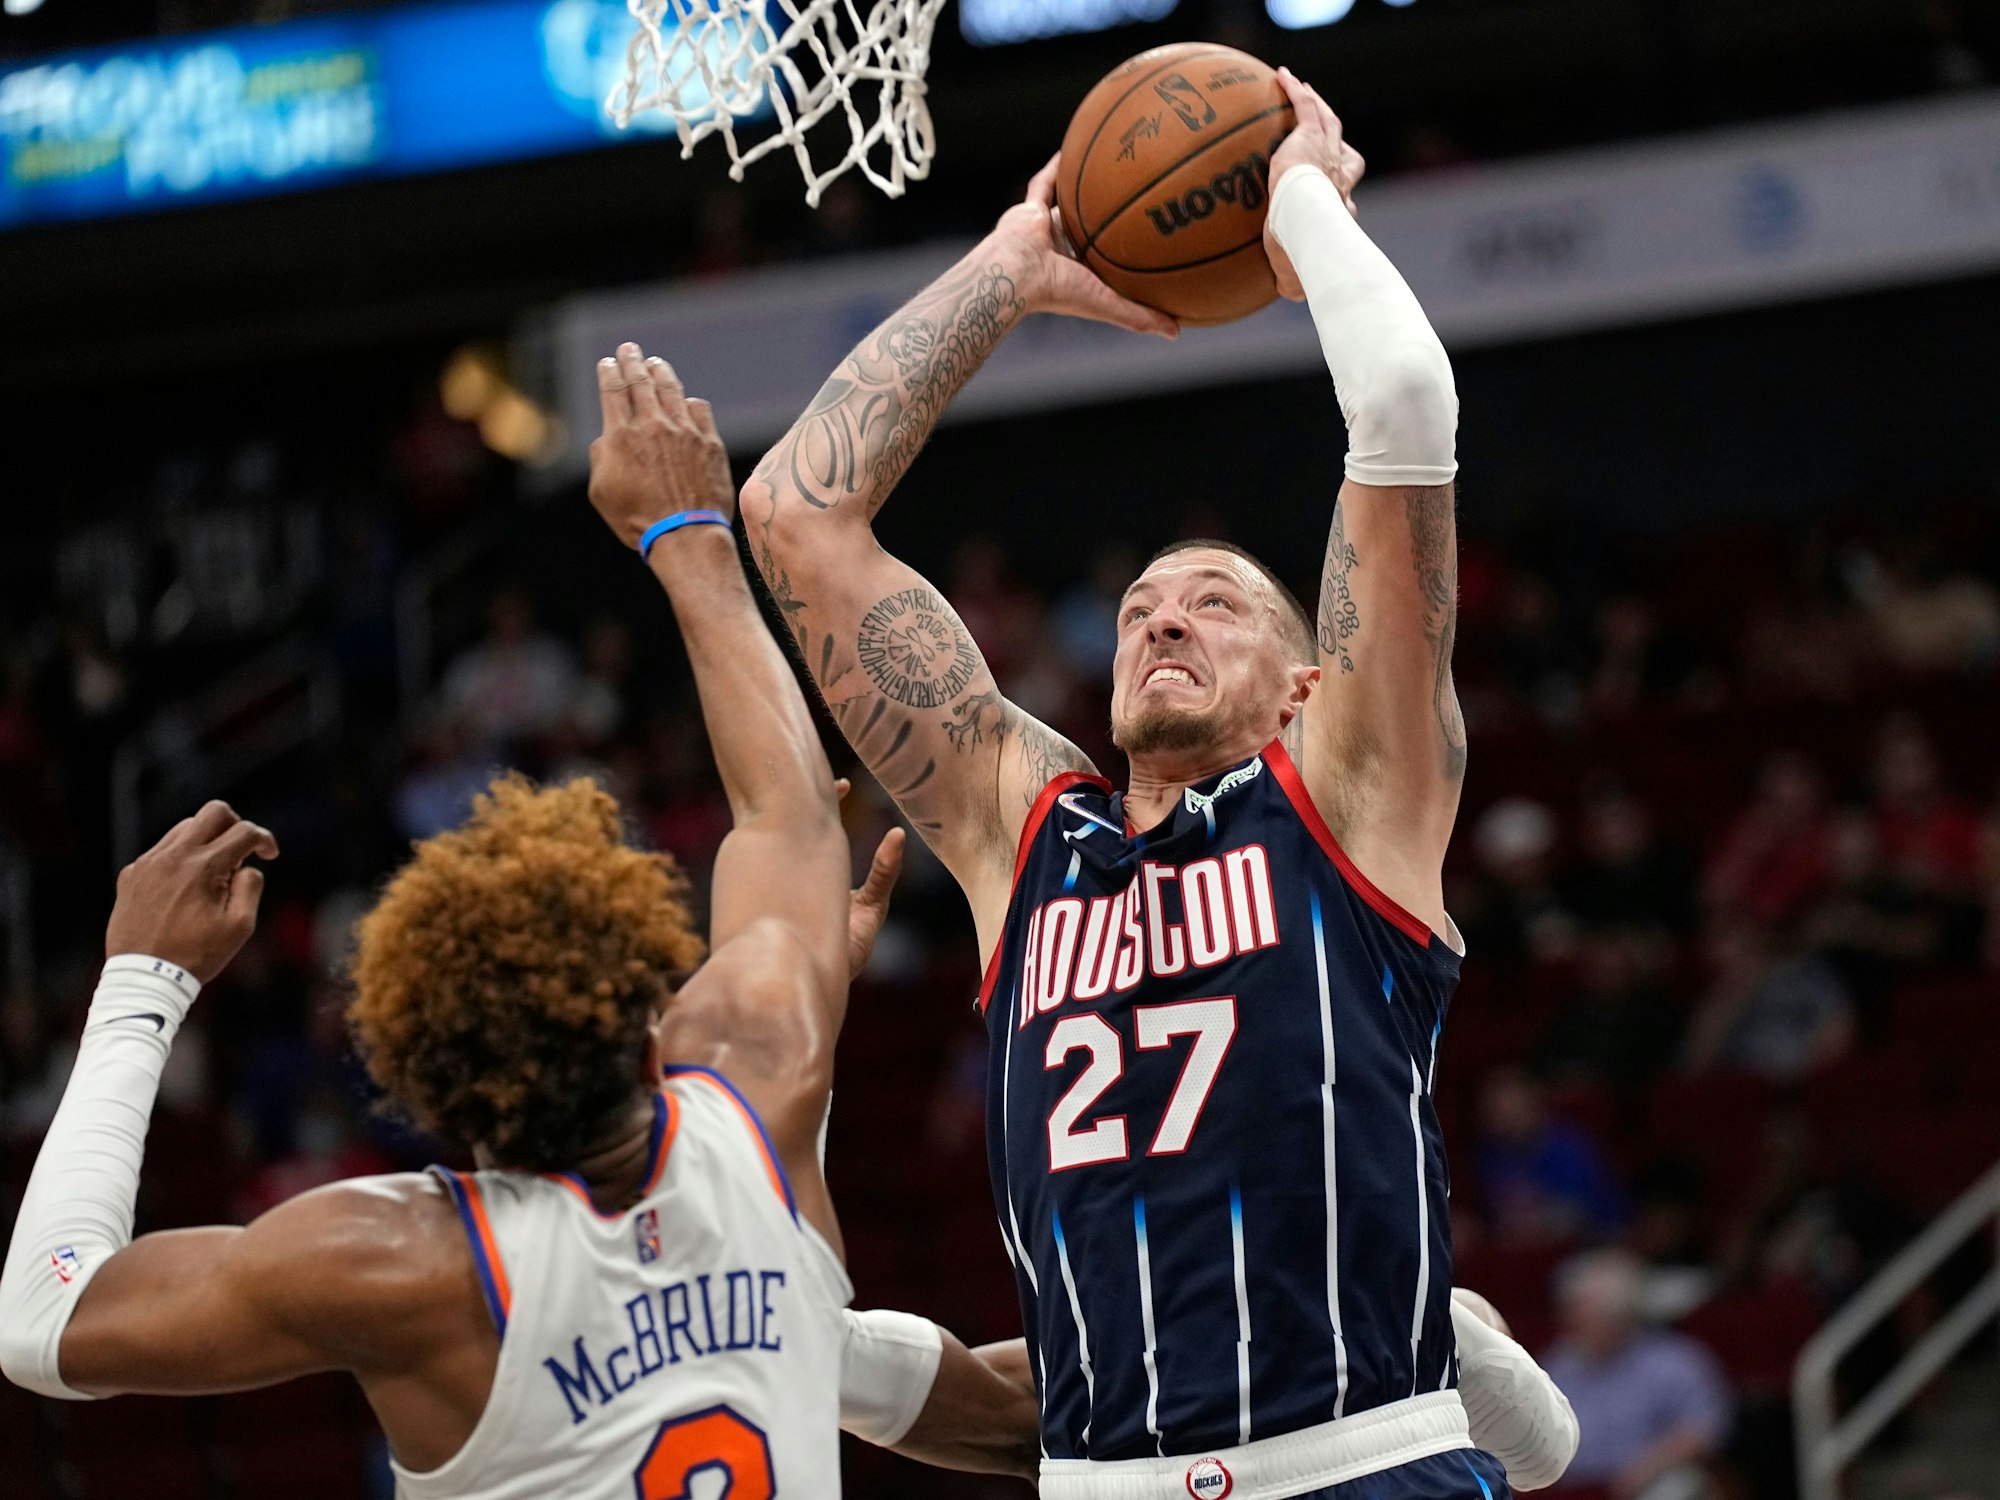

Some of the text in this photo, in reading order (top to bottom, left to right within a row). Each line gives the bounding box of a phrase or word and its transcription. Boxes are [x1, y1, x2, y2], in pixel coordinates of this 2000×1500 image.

[1018, 844, 1280, 1031] HOUSTON
[1043, 994, 1238, 1174] 27
[542, 1270, 785, 1425] McBRIDE
